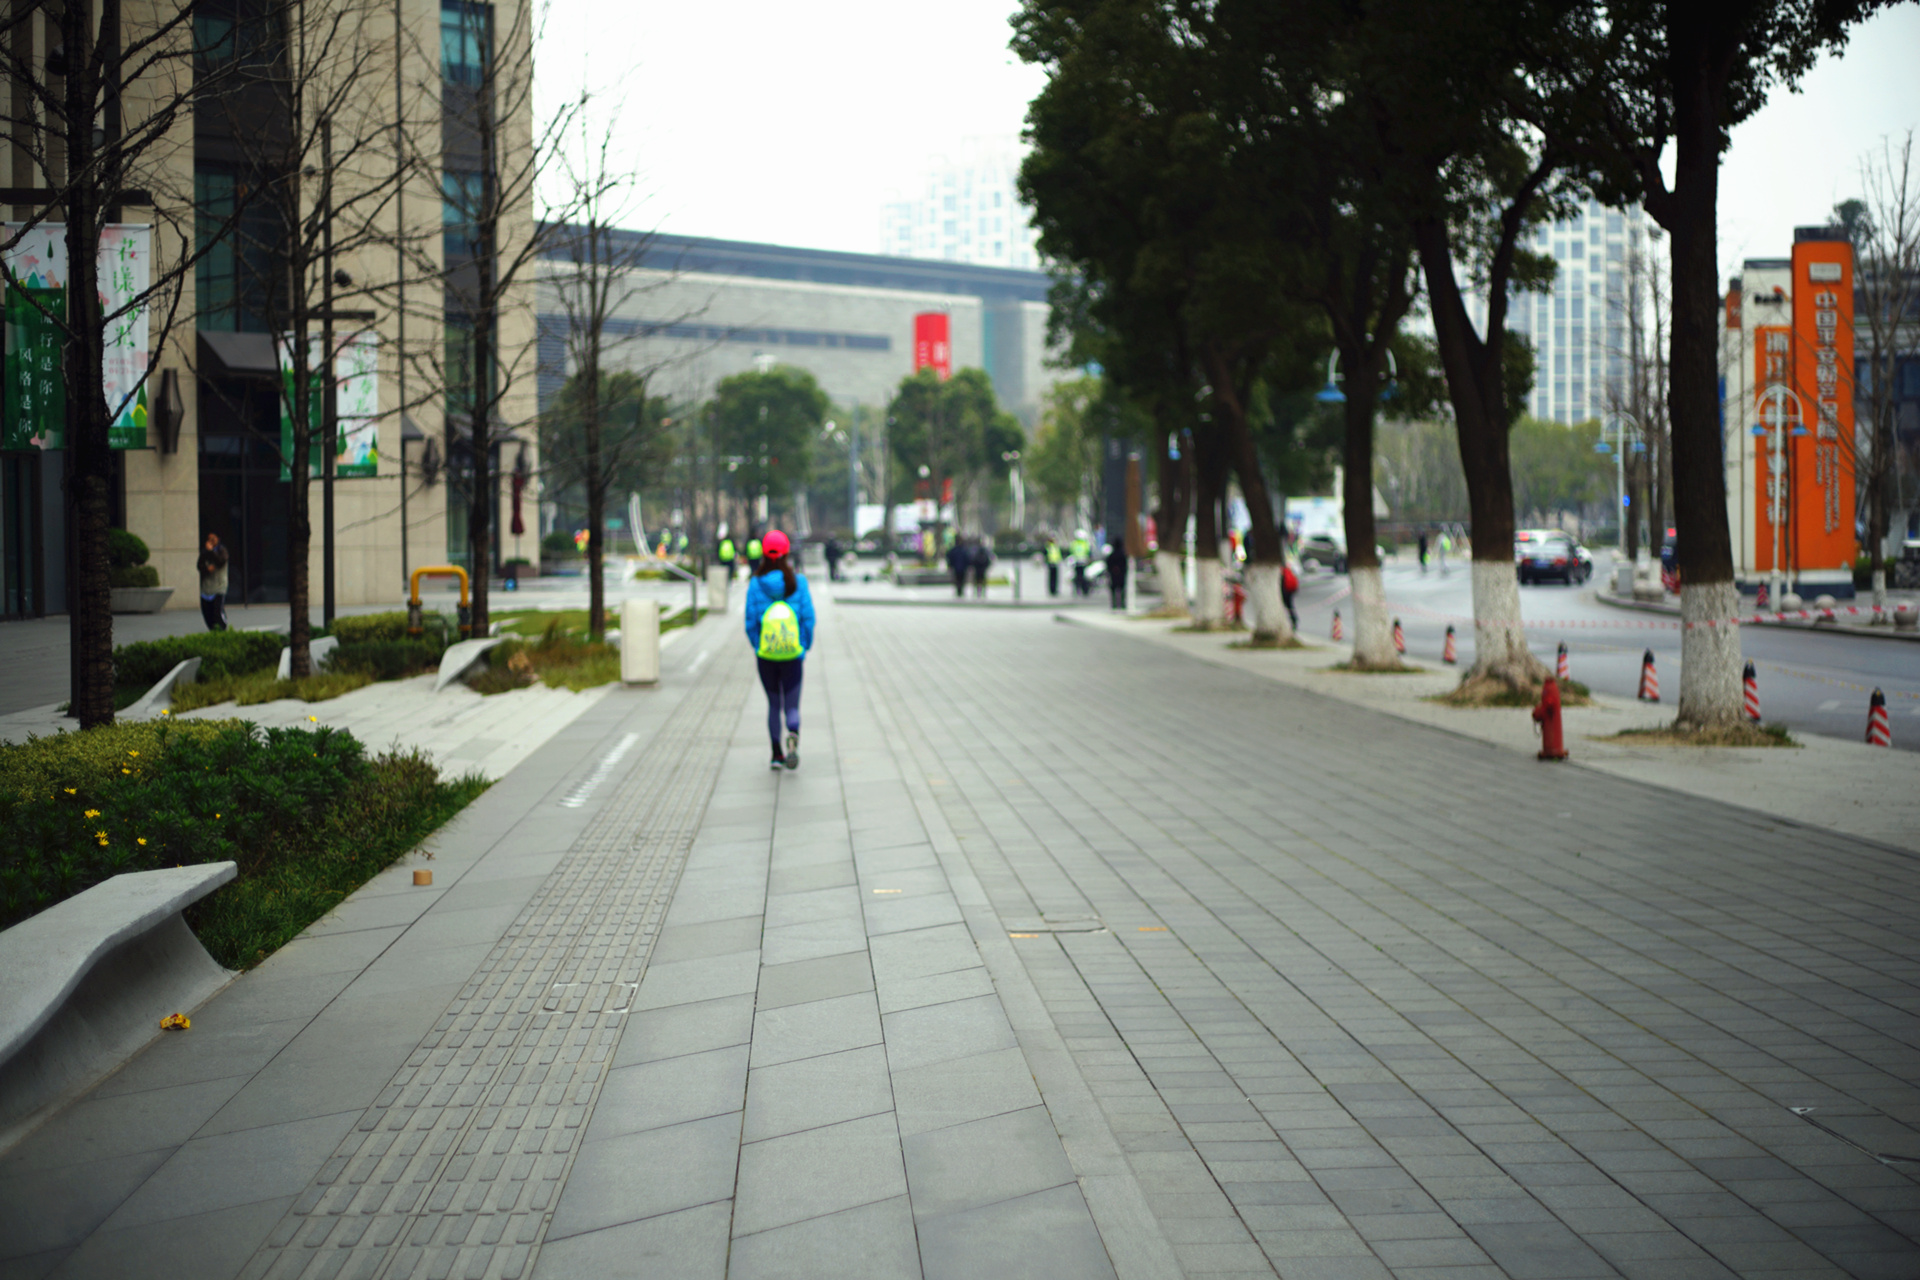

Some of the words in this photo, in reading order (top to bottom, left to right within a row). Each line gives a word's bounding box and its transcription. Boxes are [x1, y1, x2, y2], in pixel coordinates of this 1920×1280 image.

[112, 237, 140, 348] 花漾春光
[1815, 290, 1838, 441] 中国平安财产保险
